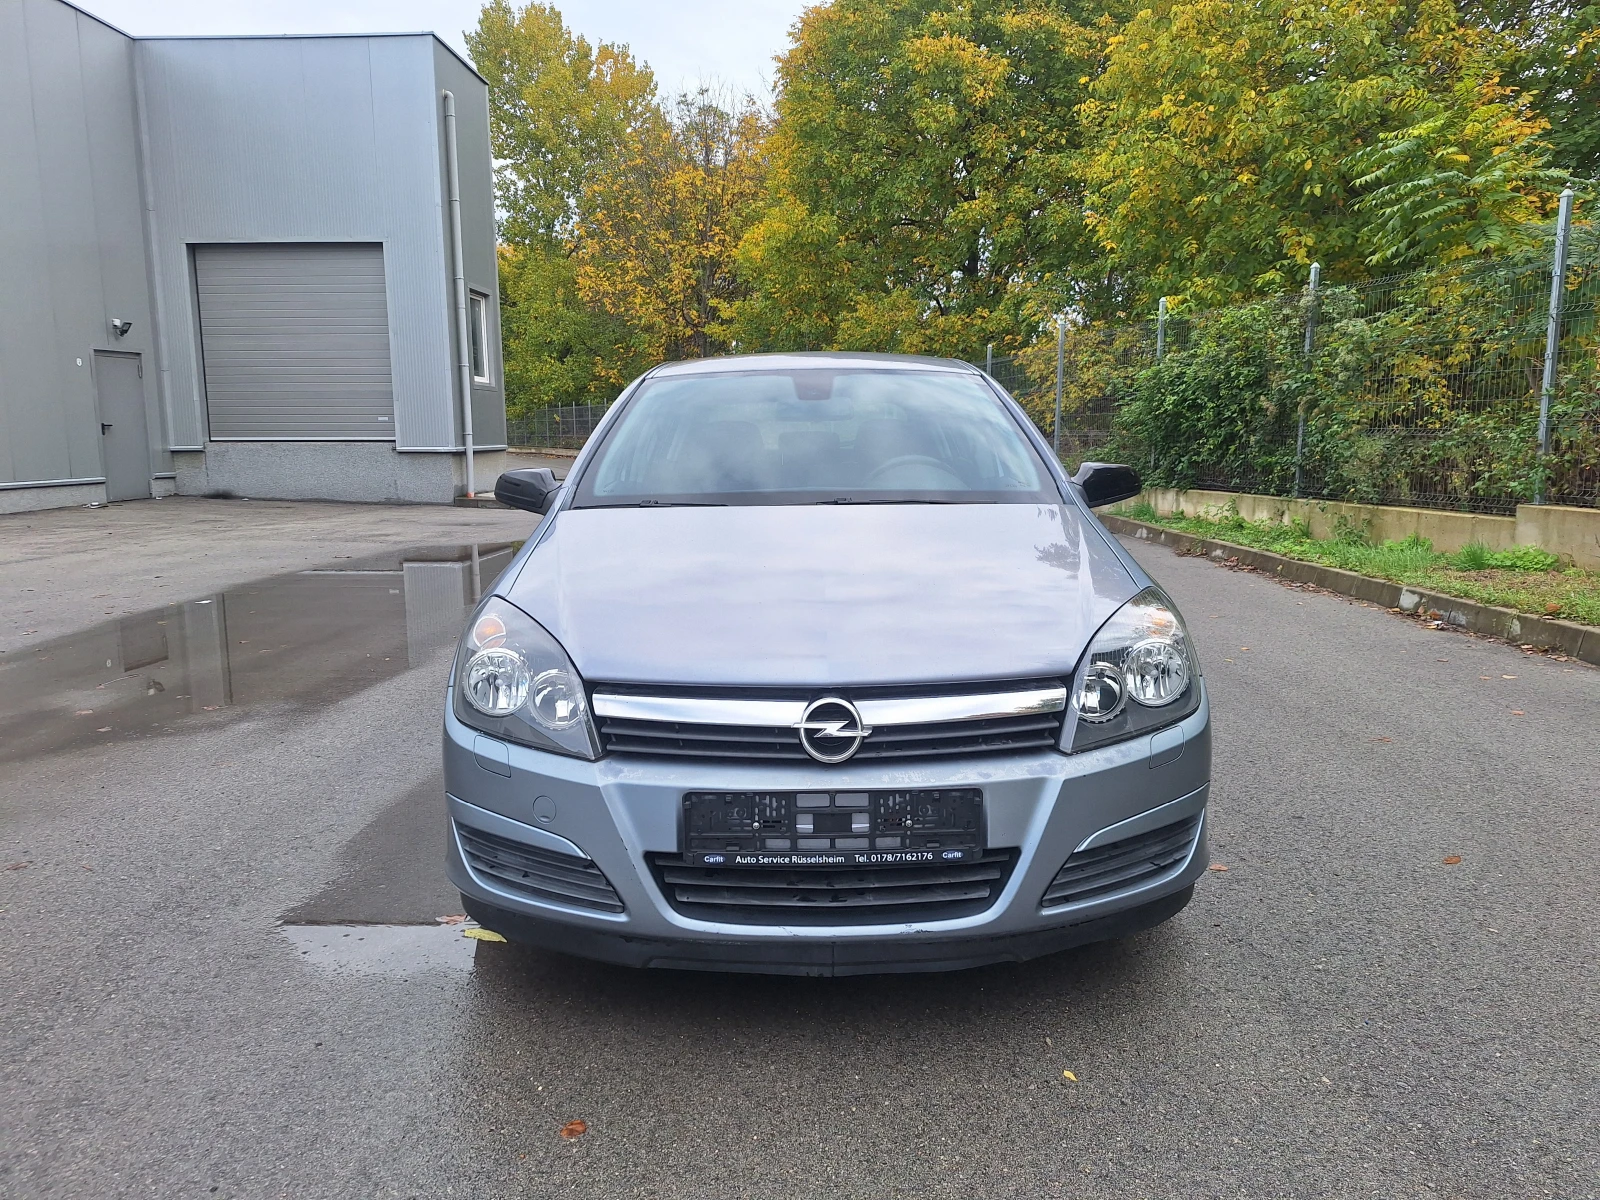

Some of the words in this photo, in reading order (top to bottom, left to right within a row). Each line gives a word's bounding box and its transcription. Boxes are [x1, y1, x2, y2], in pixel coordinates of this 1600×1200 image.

[704, 855, 724, 863] Carfit
[735, 855, 757, 864] Auto
[758, 855, 790, 864] Service
[791, 854, 845, 864] Rüsselsheim
[854, 854, 869, 863] Tel.
[871, 852, 933, 863] 0178/7162176
[942, 851, 962, 859] Carfit
